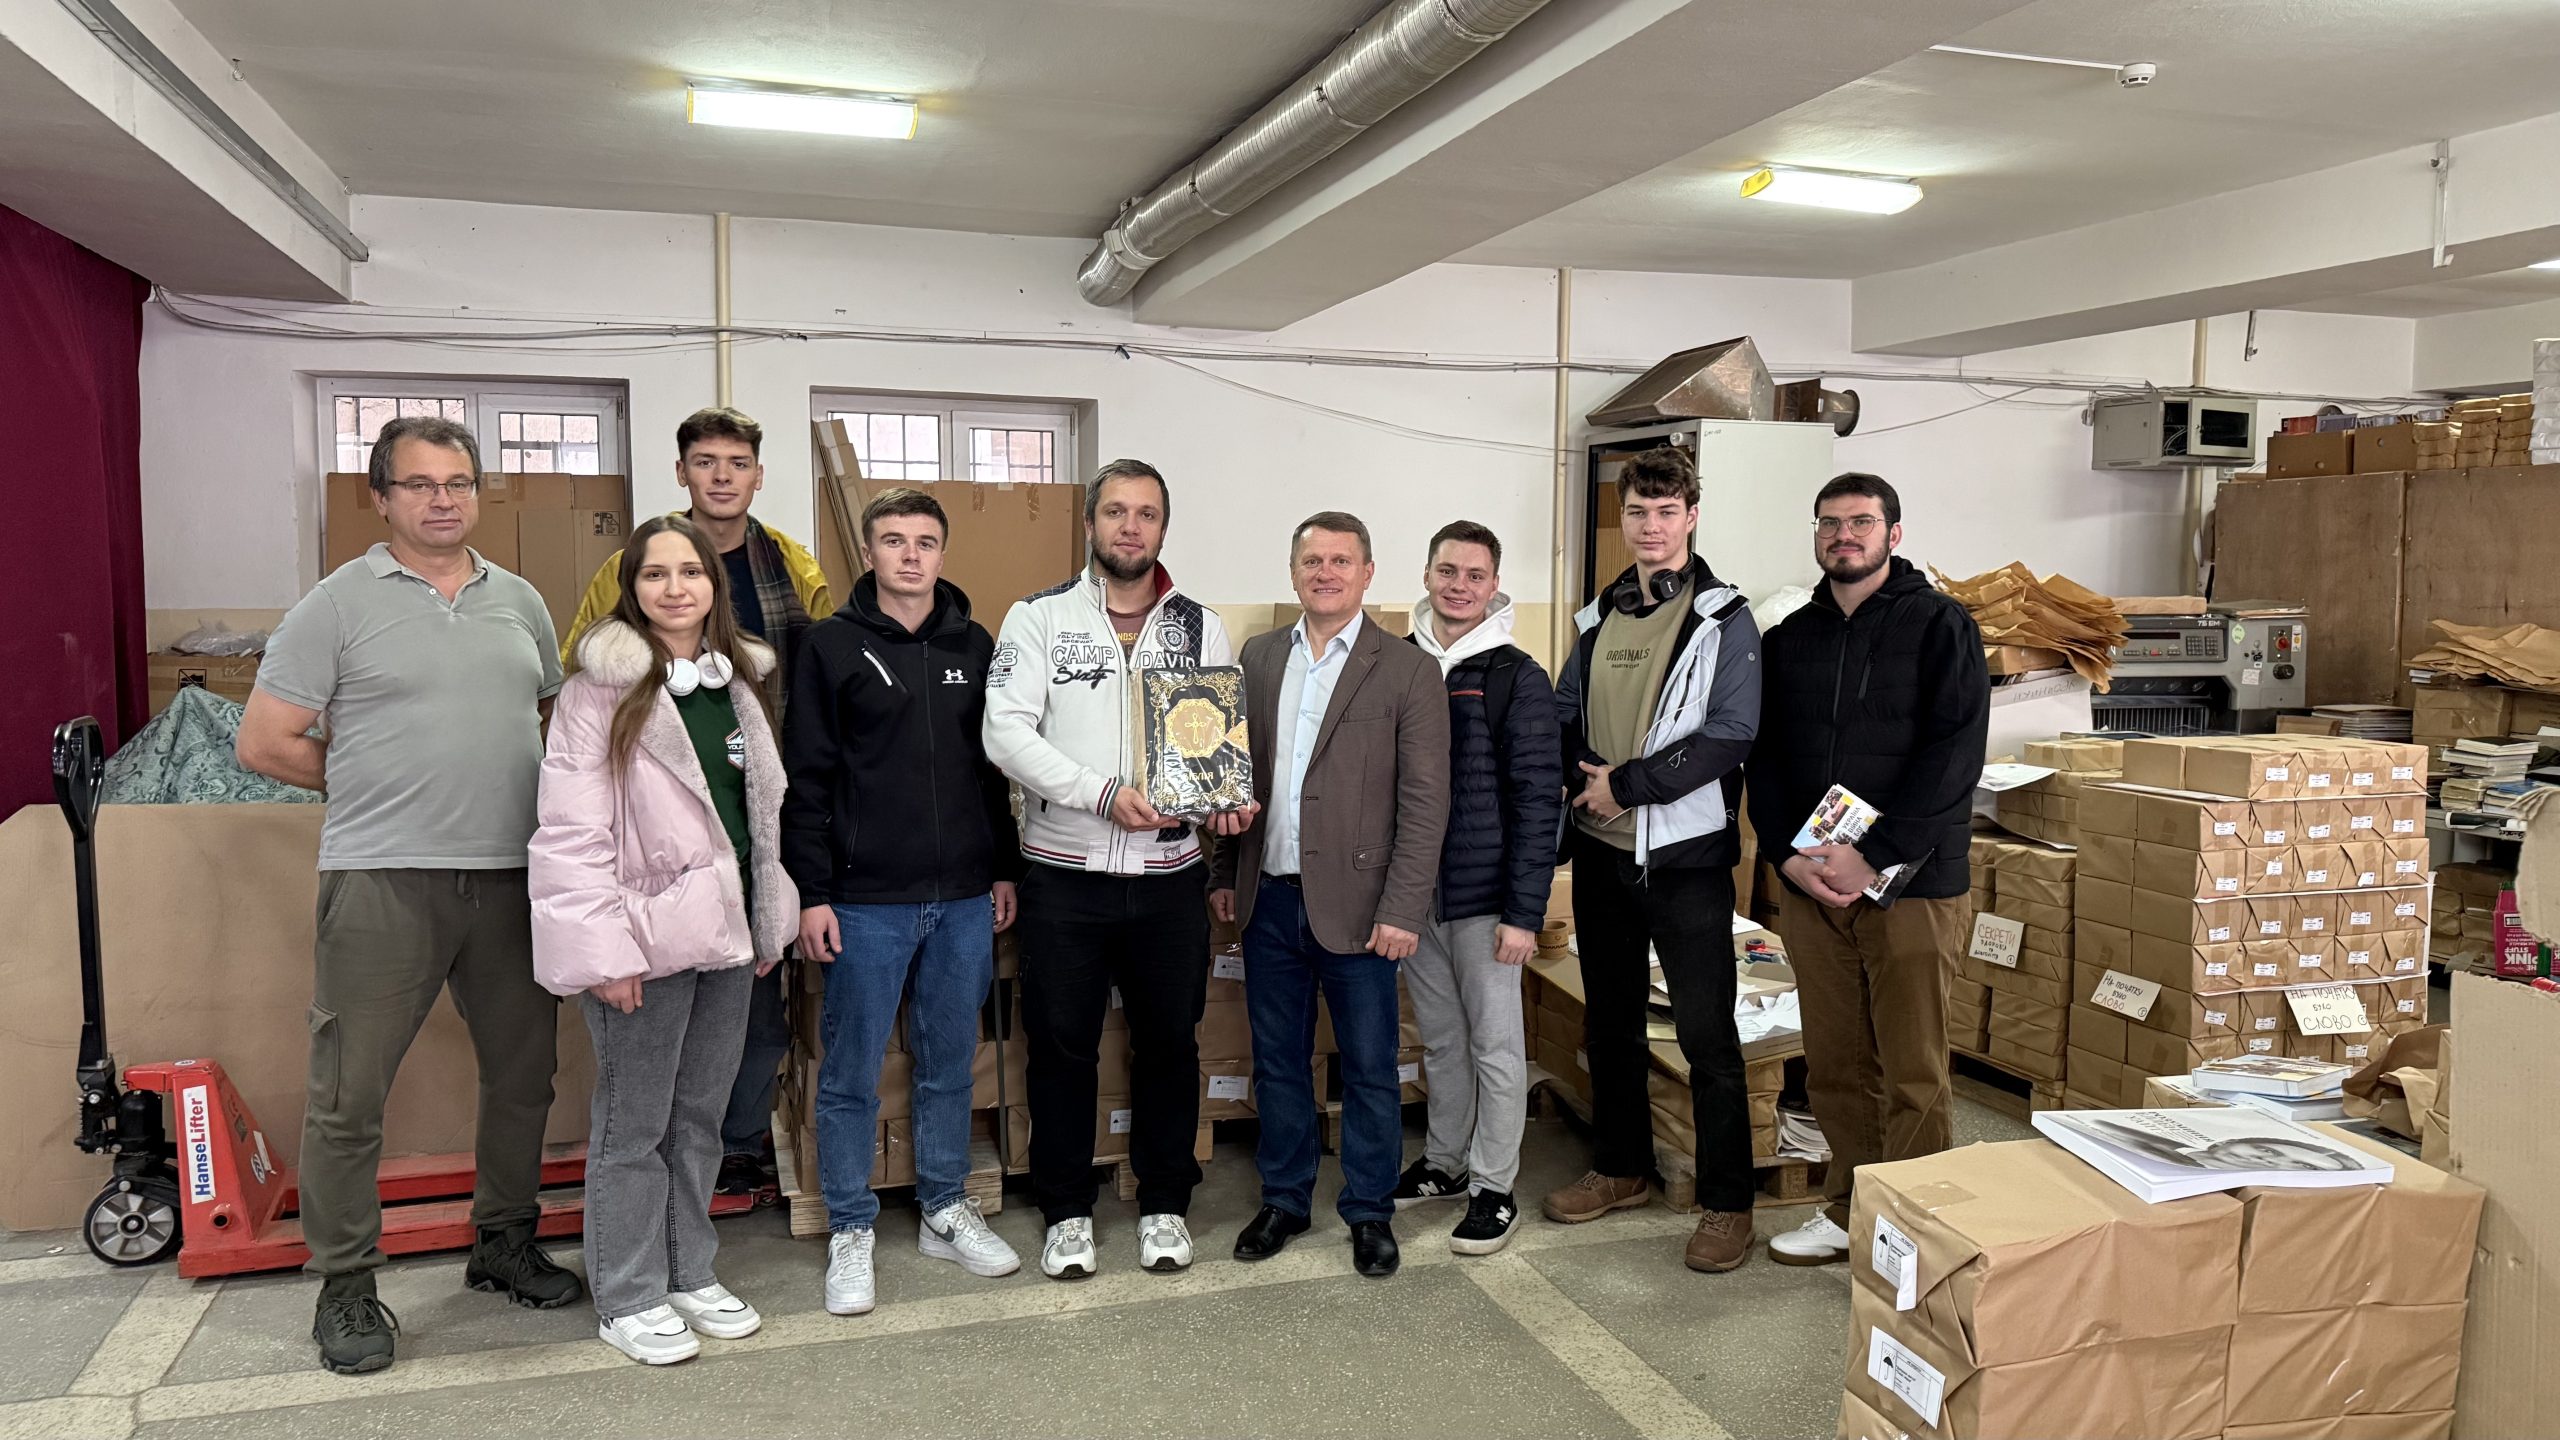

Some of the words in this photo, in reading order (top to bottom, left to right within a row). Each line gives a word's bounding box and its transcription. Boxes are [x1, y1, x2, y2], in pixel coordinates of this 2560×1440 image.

[1117, 632, 1138, 641] NDSC
[1051, 645, 1116, 667] CAMP
[1139, 650, 1196, 669] DAVID
[1606, 648, 1650, 662] ORIGINALS
[1052, 664, 1116, 690] Sixty
[1978, 924, 2016, 946] СЕКРЕТИ
[2094, 993, 2125, 1011] СЛОВО
[2303, 1014, 2352, 1030] СЛОВО
[190, 1097, 211, 1196] HanseLifter
